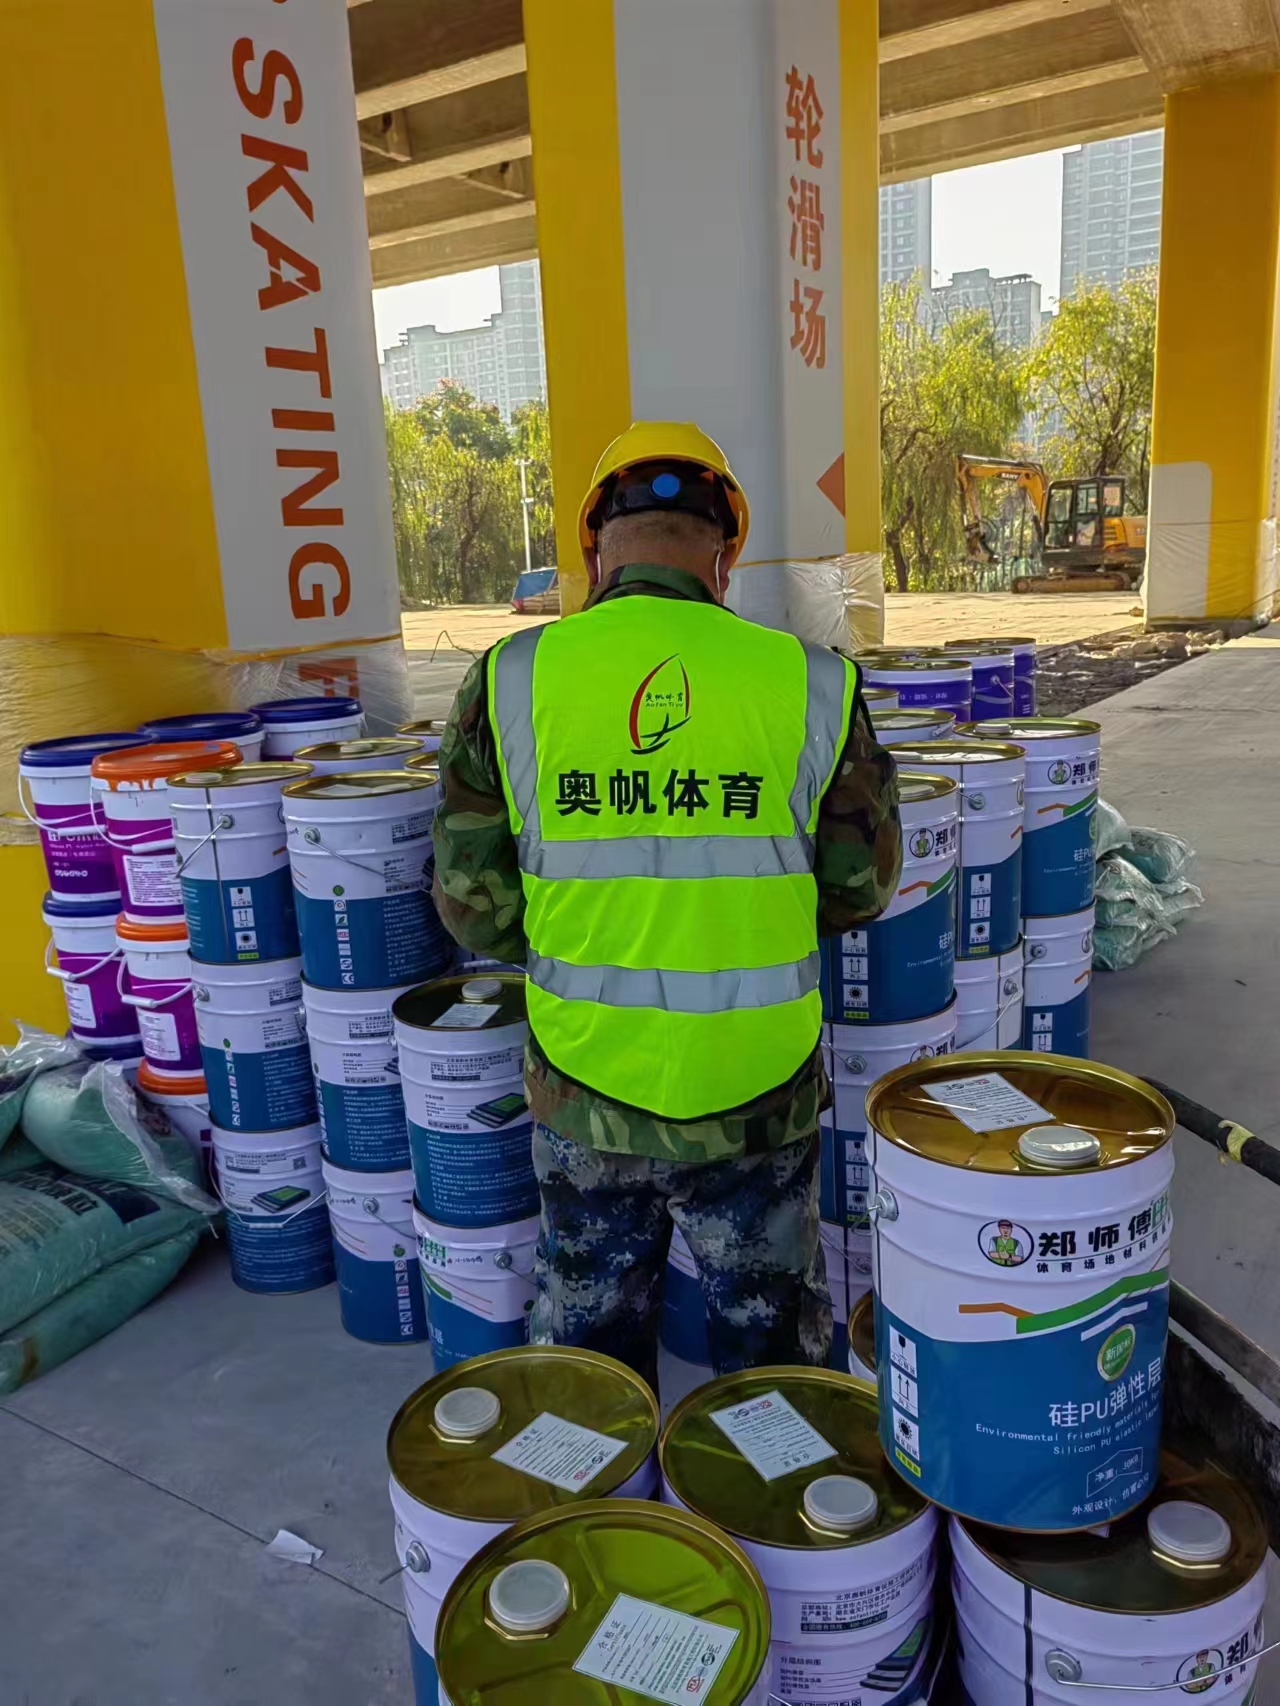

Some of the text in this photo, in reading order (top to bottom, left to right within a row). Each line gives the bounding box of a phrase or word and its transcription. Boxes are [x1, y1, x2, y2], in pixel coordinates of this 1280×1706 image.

[785, 63, 827, 370] 轮滑场
[231, 36, 352, 620] SKATING
[554, 768, 764, 820] 奥帆体育
[1038, 1207, 1152, 1257] 郑师傅
[1048, 1356, 1162, 1428] 硅PU弹性层
[975, 1423, 1059, 1442] Environmental
[1066, 1425, 1112, 1441] friendly
